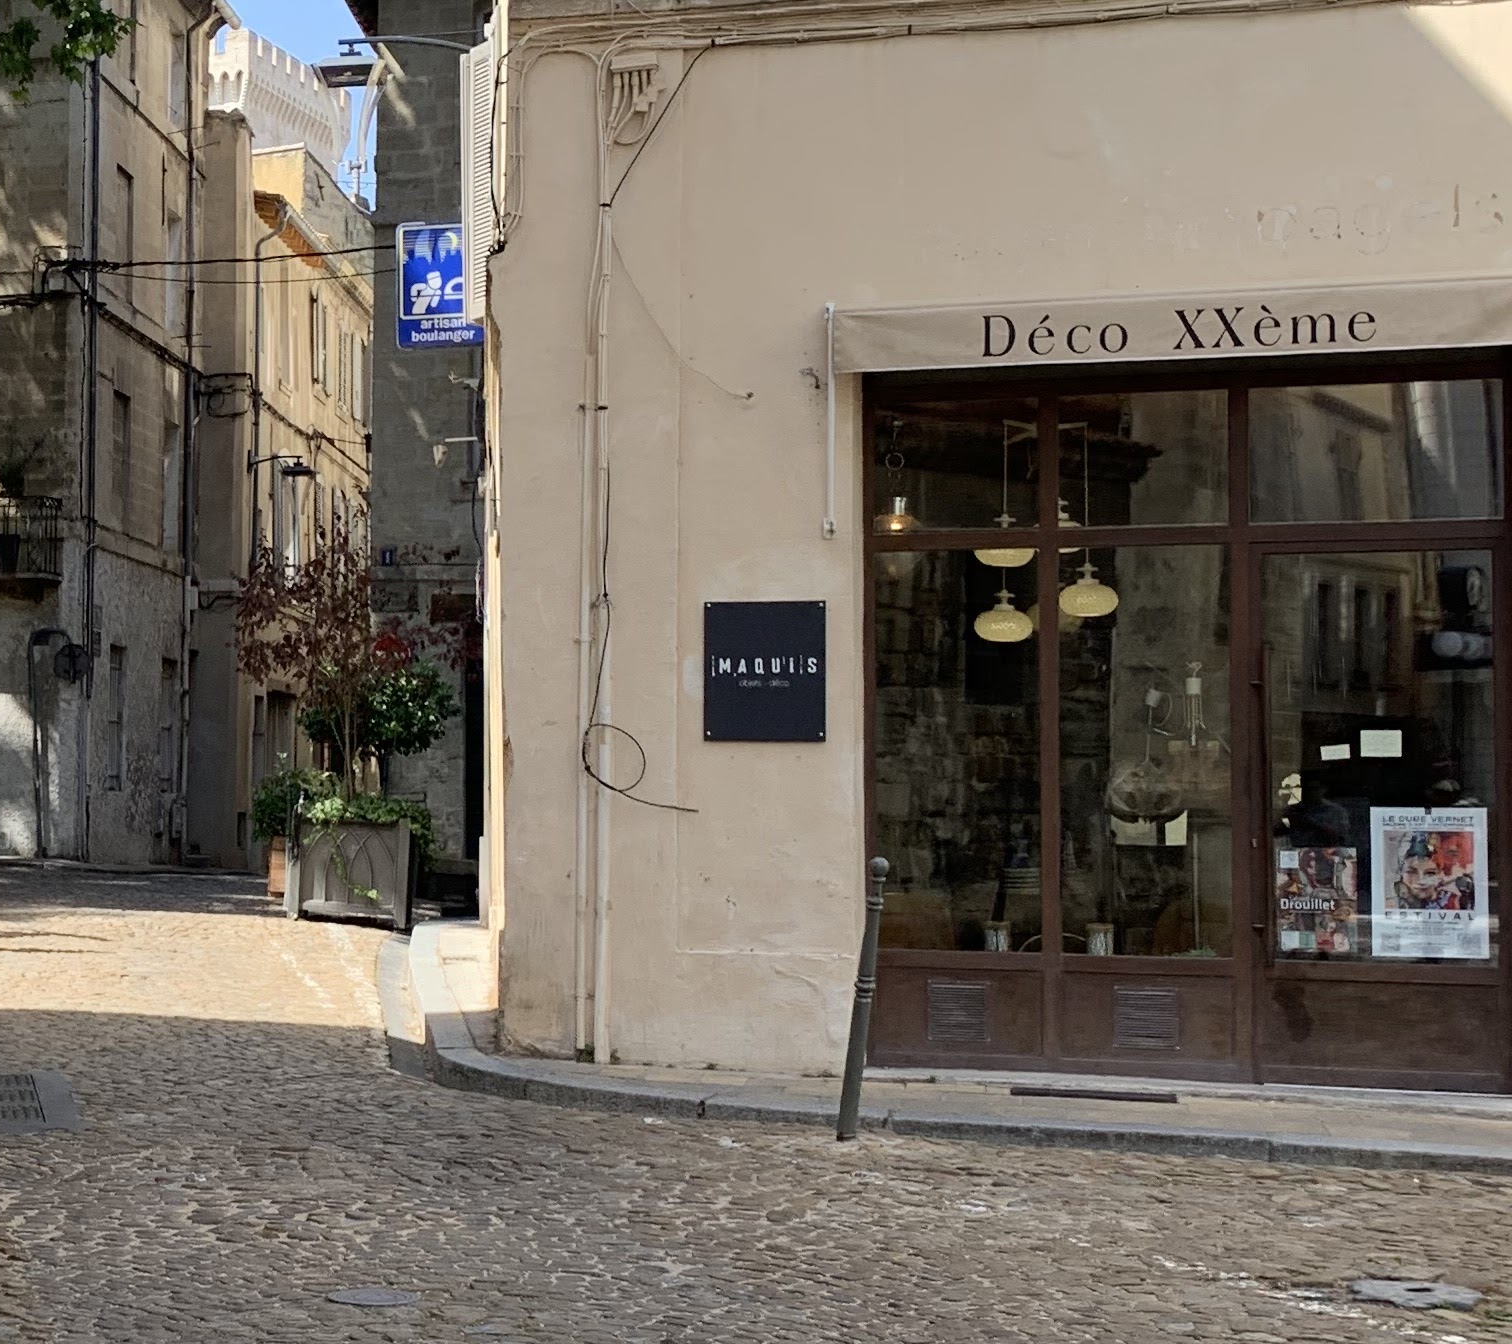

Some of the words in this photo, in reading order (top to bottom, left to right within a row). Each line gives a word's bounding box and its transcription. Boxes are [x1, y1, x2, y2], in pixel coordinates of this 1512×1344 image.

[420, 318, 467, 329] artisan
[411, 330, 475, 343] boulanger
[982, 313, 1129, 358] Déco
[1173, 304, 1378, 350] XXème
[1280, 898, 1336, 911] Drouillet
[1384, 911, 1475, 921] ESTIVAL
